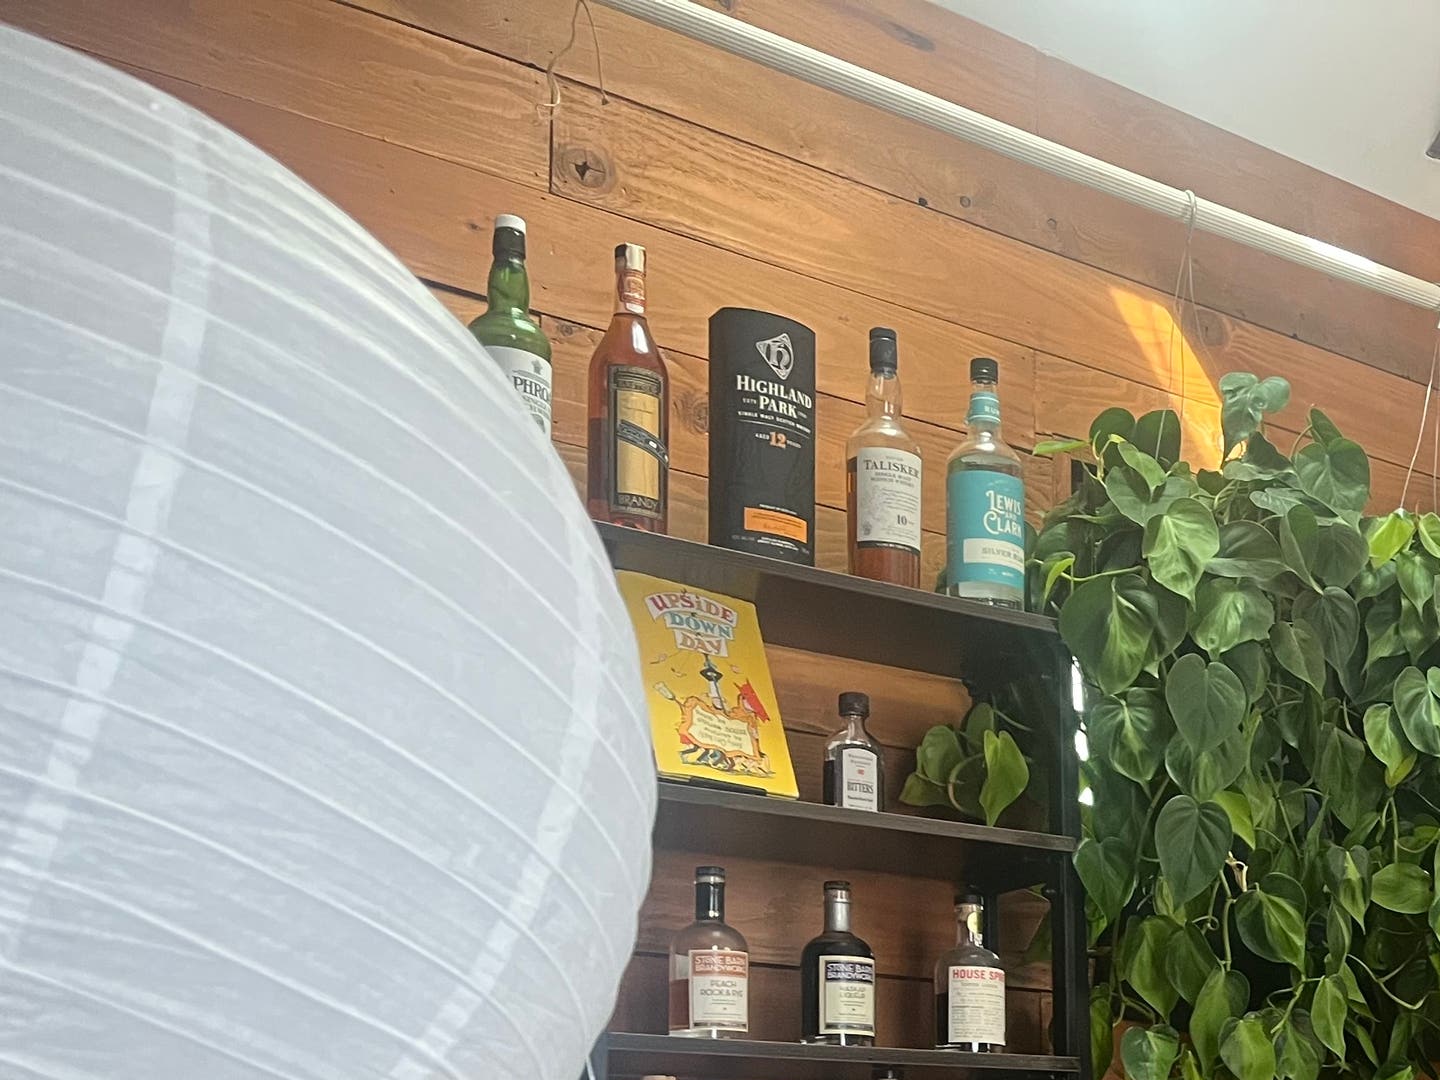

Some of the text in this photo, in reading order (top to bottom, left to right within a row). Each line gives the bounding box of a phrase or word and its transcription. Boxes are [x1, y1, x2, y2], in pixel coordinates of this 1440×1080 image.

[512, 374, 550, 402] PHRO
[736, 374, 812, 409] HIGHLAND
[759, 395, 798, 419] PARK
[769, 431, 787, 449] 12
[618, 494, 658, 512] BRANDY
[985, 489, 1022, 515] LEWIS
[896, 514, 908, 526] 10
[982, 547, 1012, 558] SILVER
[670, 612, 732, 638] DOWN
[680, 631, 722, 655] DAY
[847, 781, 874, 795] BITTERS
[952, 968, 986, 980] HOUSE
